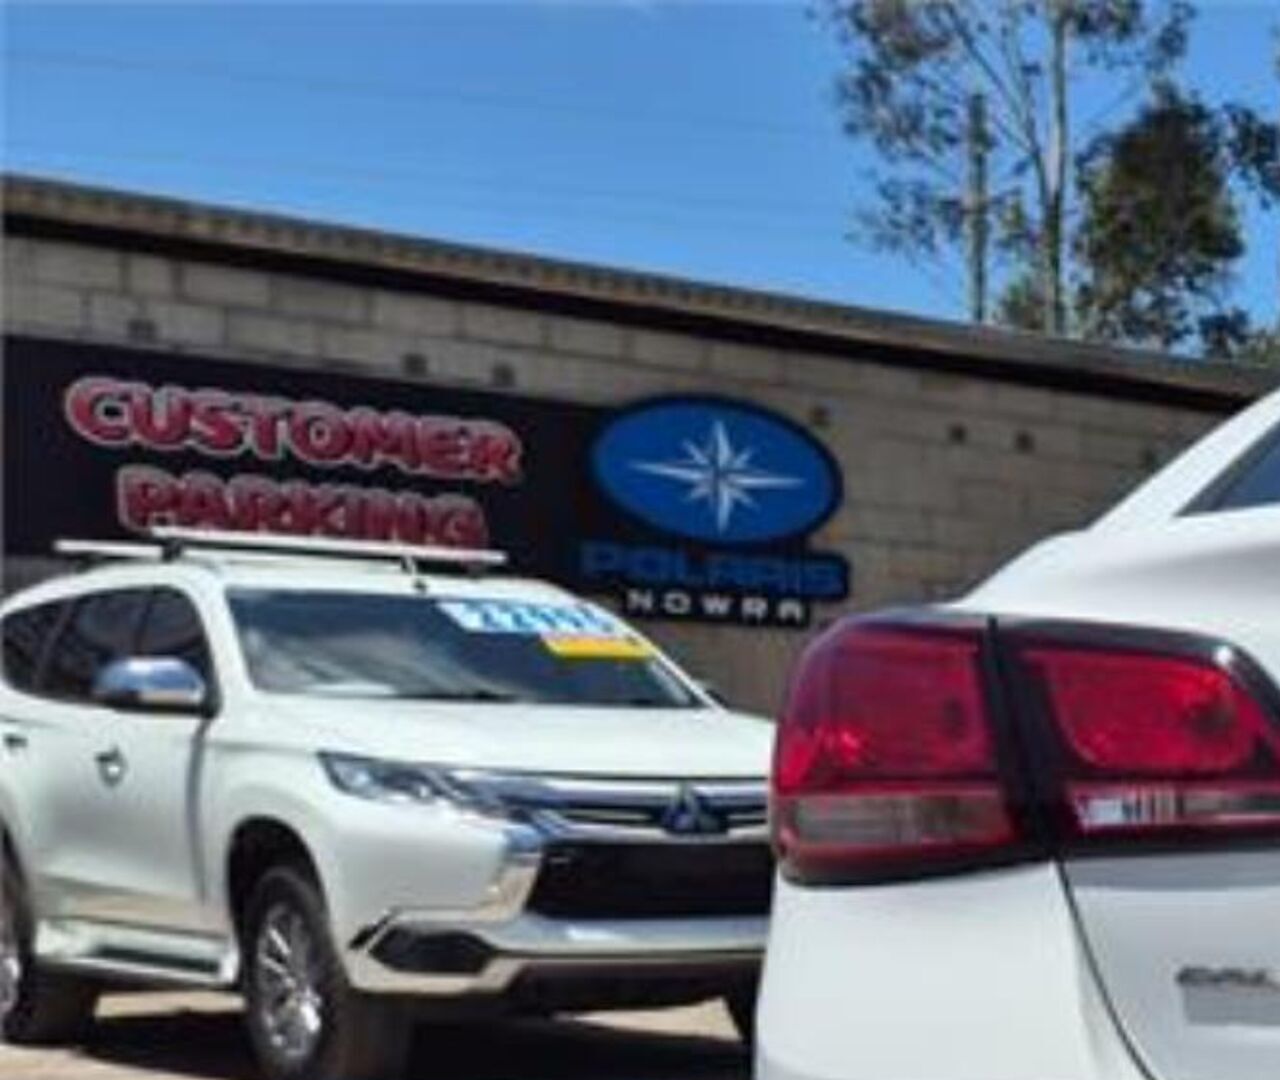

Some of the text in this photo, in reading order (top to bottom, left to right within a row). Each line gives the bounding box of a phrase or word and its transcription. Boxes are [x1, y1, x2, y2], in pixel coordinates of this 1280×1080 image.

[64, 377, 523, 483] CUSTOMER
[116, 465, 488, 550] PARKING
[585, 541, 847, 594] POLARIS
[626, 588, 806, 621] NOWRA
